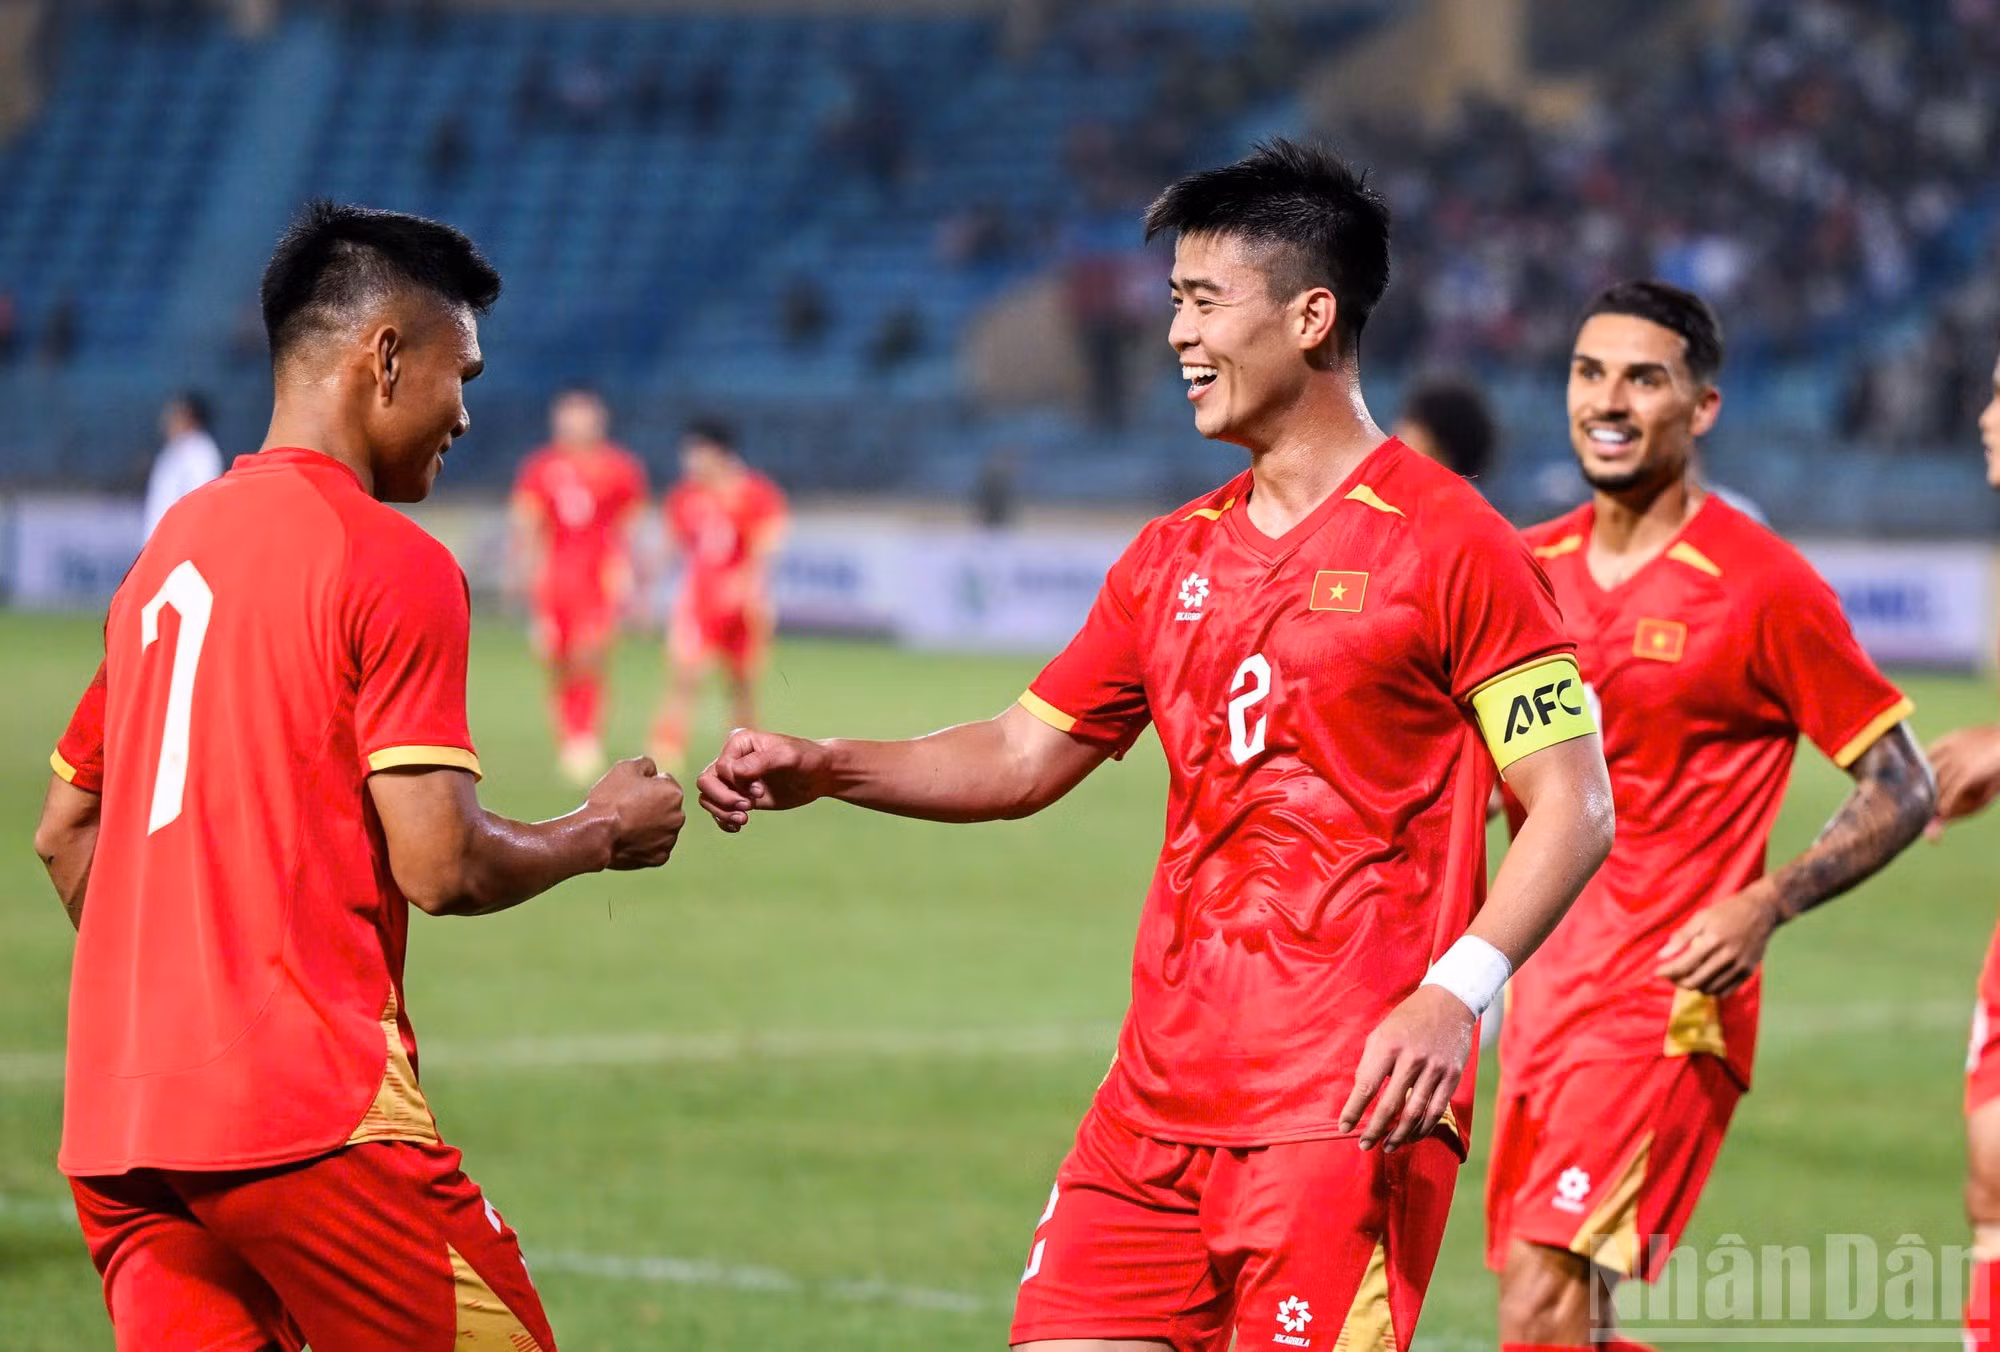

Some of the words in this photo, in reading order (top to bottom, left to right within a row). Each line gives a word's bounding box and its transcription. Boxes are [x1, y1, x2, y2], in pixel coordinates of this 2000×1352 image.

[141, 560, 213, 834] 7
[1228, 652, 1271, 765] 2
[1504, 678, 1582, 744] AFC
